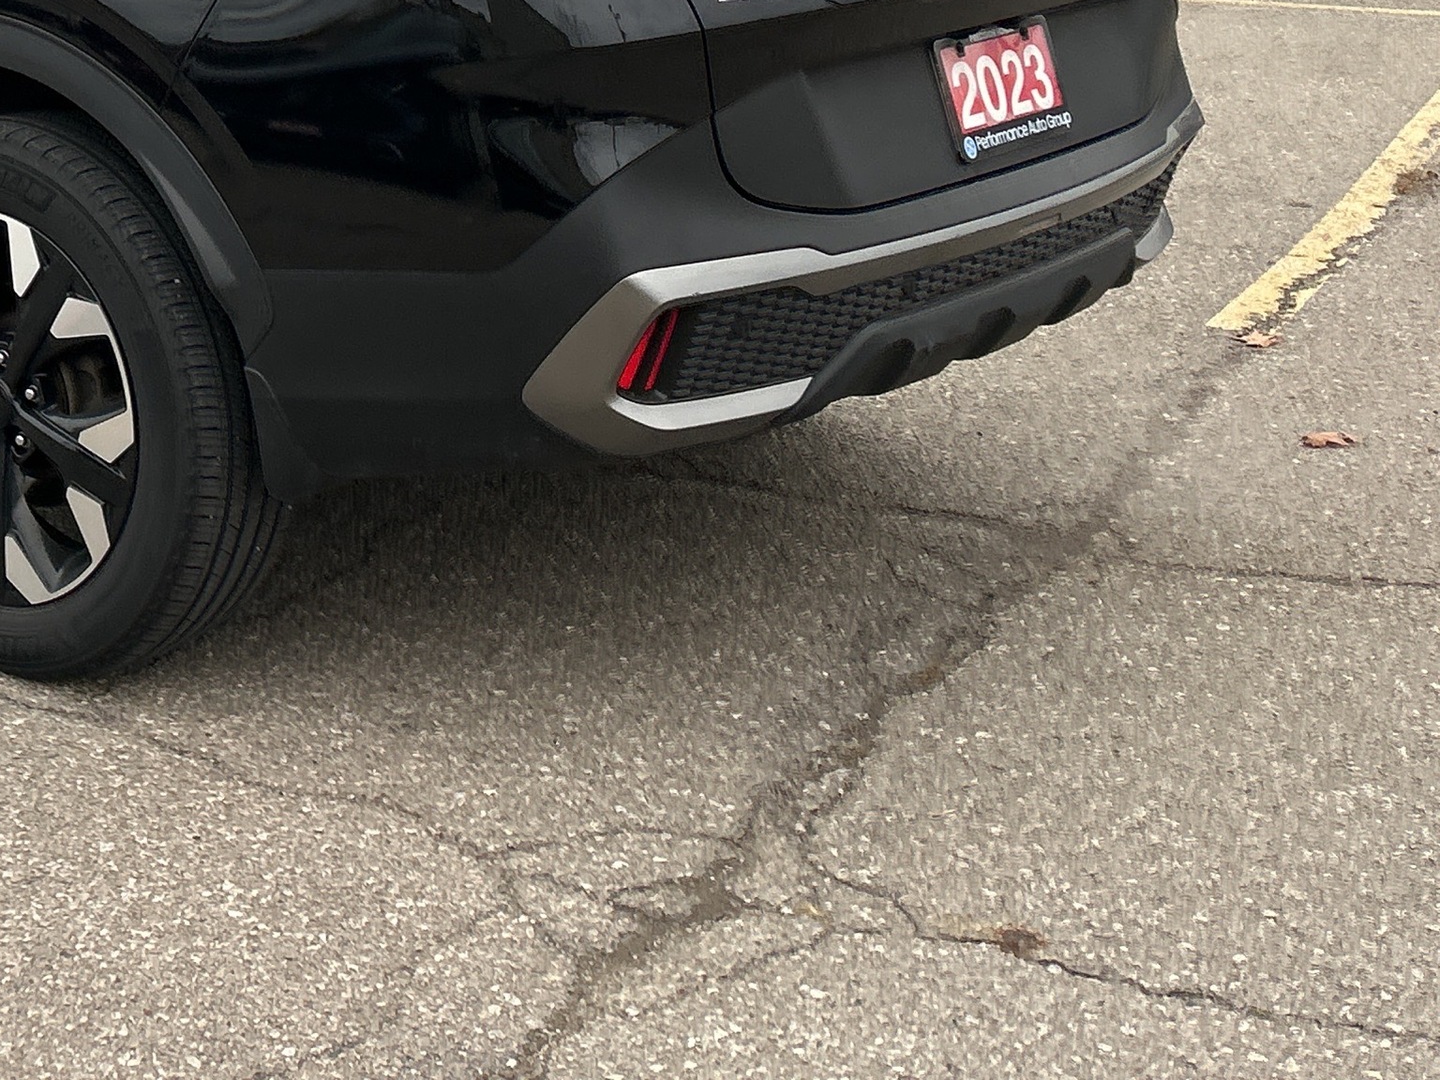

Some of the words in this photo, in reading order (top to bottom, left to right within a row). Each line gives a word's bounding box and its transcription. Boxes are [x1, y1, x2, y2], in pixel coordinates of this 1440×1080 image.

[951, 44, 1054, 129] 2023
[974, 124, 1030, 151] Performance
[1028, 117, 1048, 135] Auto
[1045, 111, 1072, 129] Group
